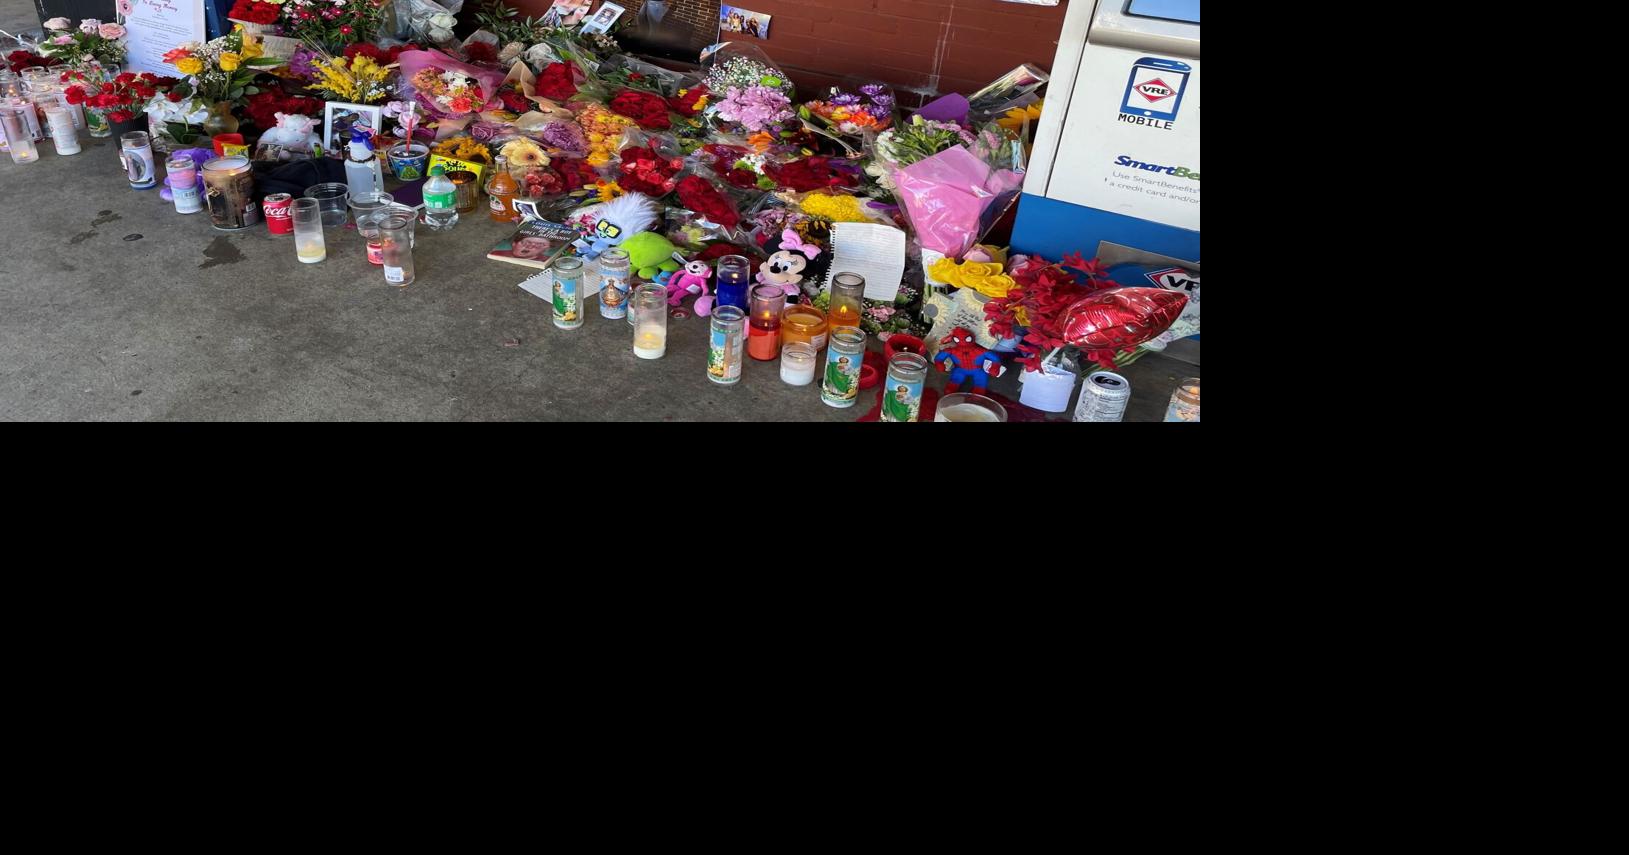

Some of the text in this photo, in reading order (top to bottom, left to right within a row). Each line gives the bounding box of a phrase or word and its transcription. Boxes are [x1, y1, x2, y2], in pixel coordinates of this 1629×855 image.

[1142, 85, 1169, 95] VRE
[1118, 113, 1174, 130] MOBILE
[1112, 170, 1130, 180] Use
[1117, 183, 1143, 193] credit
[1145, 188, 1167, 198] card
